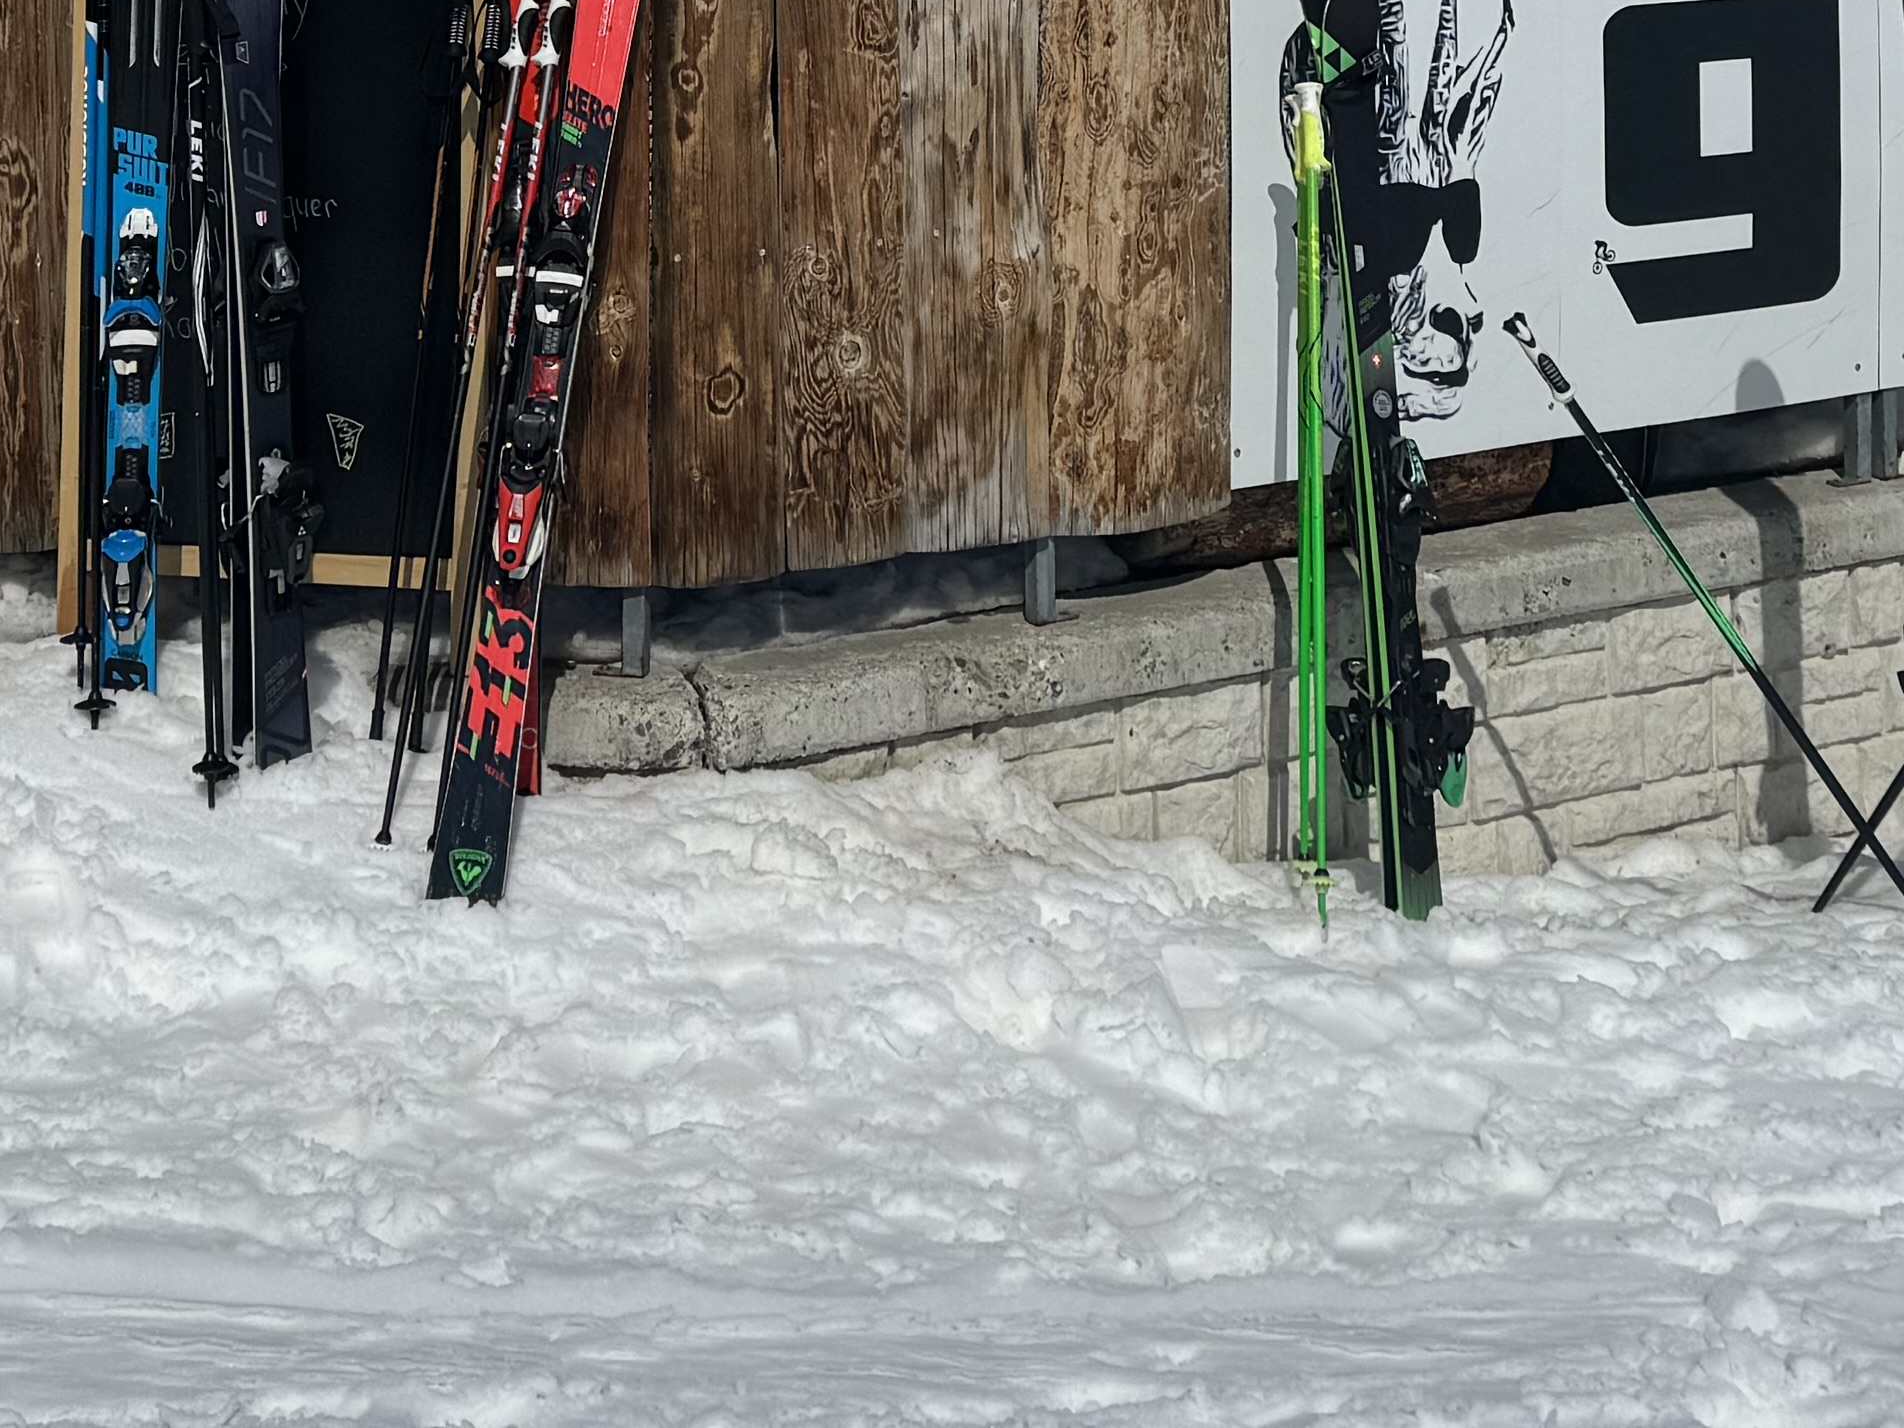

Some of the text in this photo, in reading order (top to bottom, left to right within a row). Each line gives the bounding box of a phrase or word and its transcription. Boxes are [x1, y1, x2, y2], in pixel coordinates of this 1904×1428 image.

[567, 79, 616, 130] HERO
[112, 126, 158, 160] PUR
[188, 118, 204, 183] LEKI
[116, 152, 170, 187] SUIT
